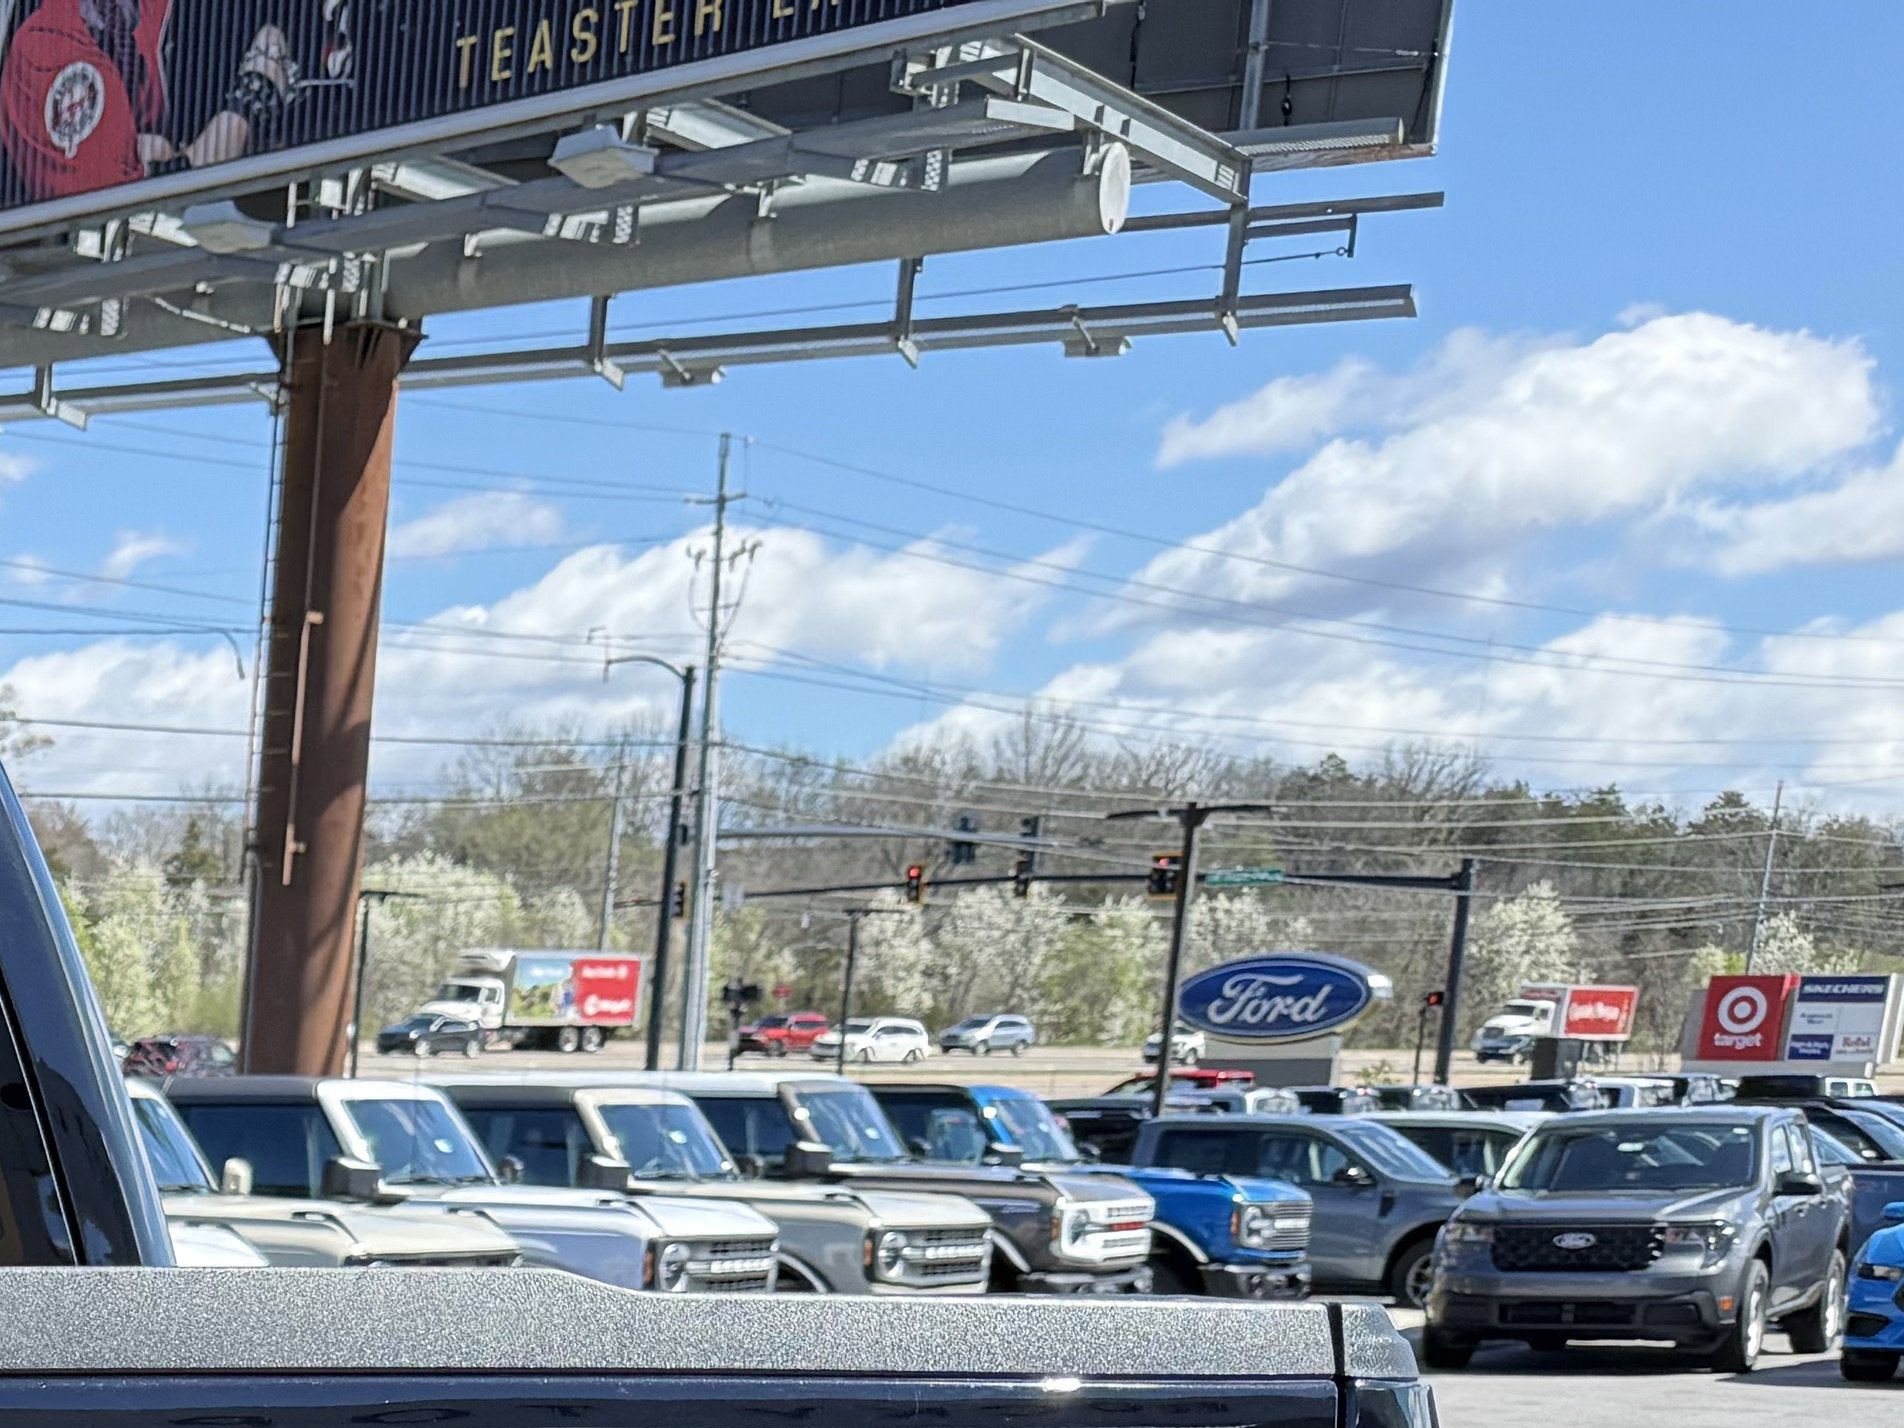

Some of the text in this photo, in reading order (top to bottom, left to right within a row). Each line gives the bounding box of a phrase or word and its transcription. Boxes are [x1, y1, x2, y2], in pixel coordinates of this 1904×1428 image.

[455, 0, 723, 89] TEASTER
[1206, 972, 1335, 1025] Ford
[1713, 1032, 1764, 1050] target
